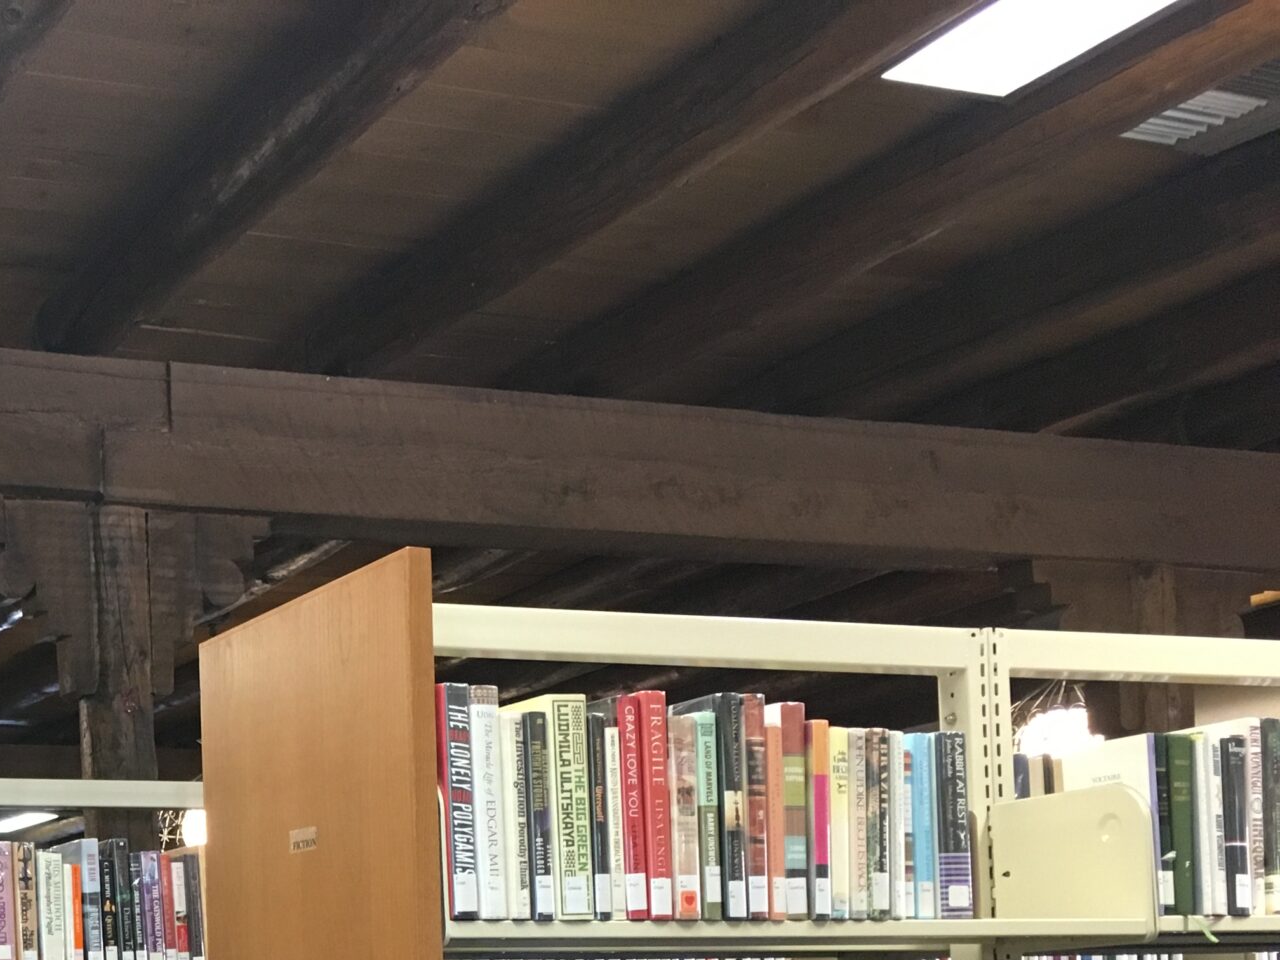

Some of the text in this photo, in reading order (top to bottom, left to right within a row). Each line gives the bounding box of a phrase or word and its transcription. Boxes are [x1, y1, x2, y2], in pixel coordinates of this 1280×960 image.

[448, 704, 472, 792] THE LONELY
[624, 705, 636, 749] CRAZY
[626, 753, 638, 785] LOVE
[649, 703, 664, 787] FRAGILE
[557, 704, 575, 848] LUDMILA ULITSKAYA
[628, 791, 639, 818] YOU
[954, 737, 967, 825] RABBIT AT REST
[486, 800, 498, 849] EDGAR
[574, 767, 588, 872] THE BIG GREEN
